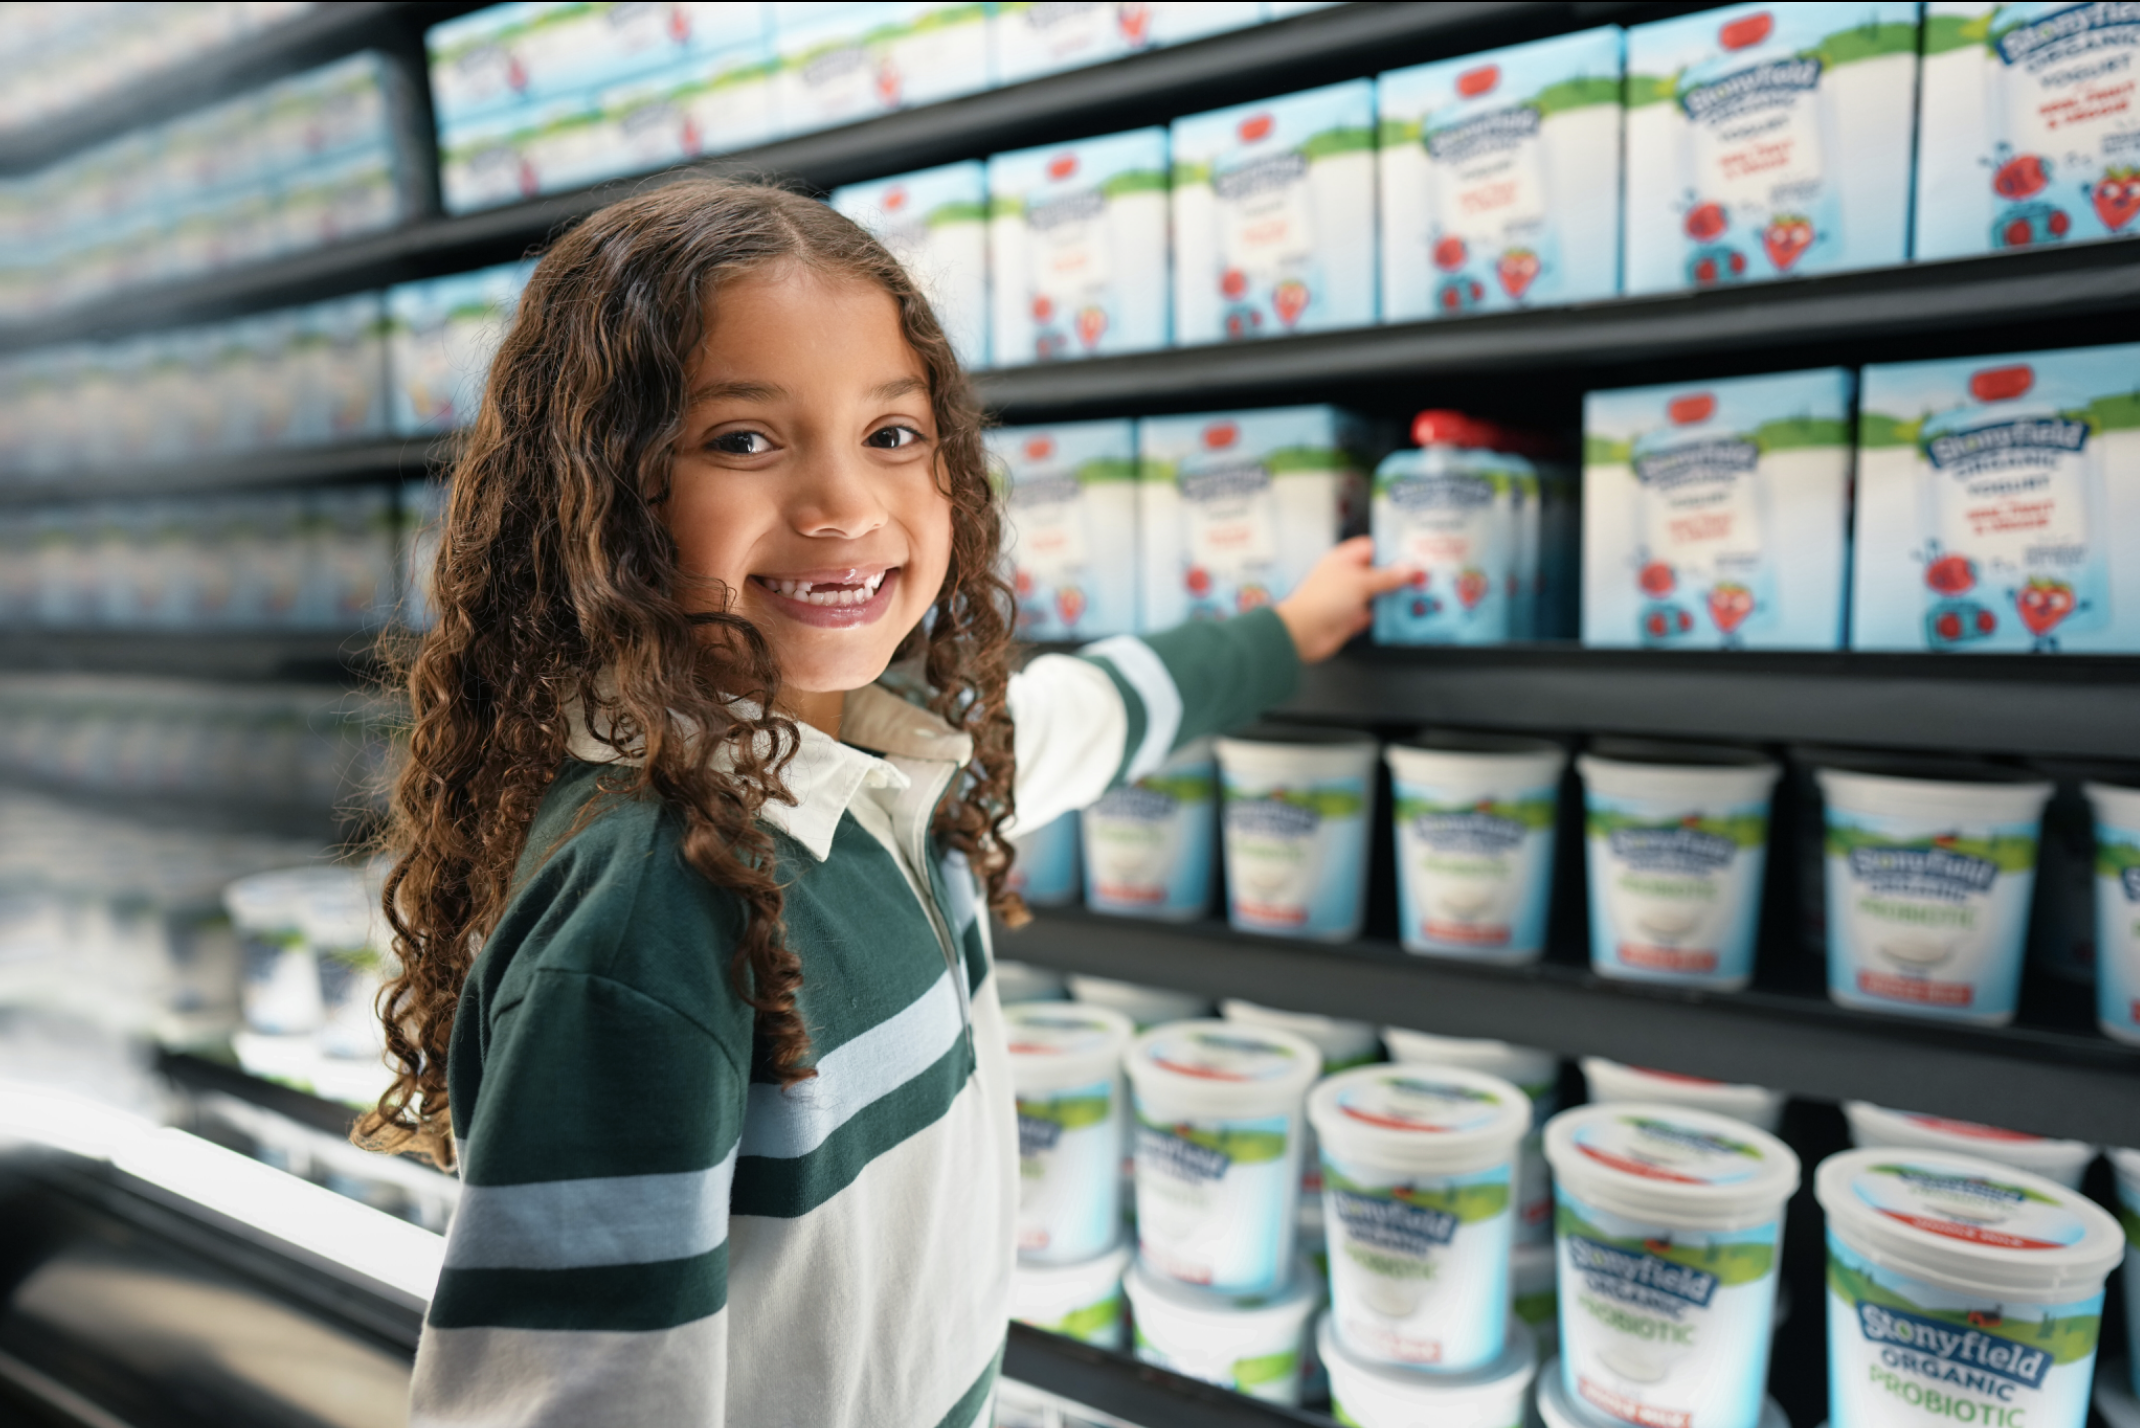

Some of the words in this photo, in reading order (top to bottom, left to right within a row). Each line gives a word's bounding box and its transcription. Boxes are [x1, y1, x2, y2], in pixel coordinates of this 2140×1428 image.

[1686, 60, 1816, 113] Stonyfield
[2040, 52, 2131, 87] YOGURT
[1933, 421, 2082, 462] Stonyfield
[1967, 475, 2050, 497] YOGURT
[1572, 1237, 1714, 1300] Stonyfield
[1578, 1293, 1698, 1345] PROBIOTIC
[1862, 1304, 2044, 1381] Stonyfield
[1869, 1364, 2026, 1428] PROBIOTIC
[1882, 1347, 2016, 1402] ORGANIC
